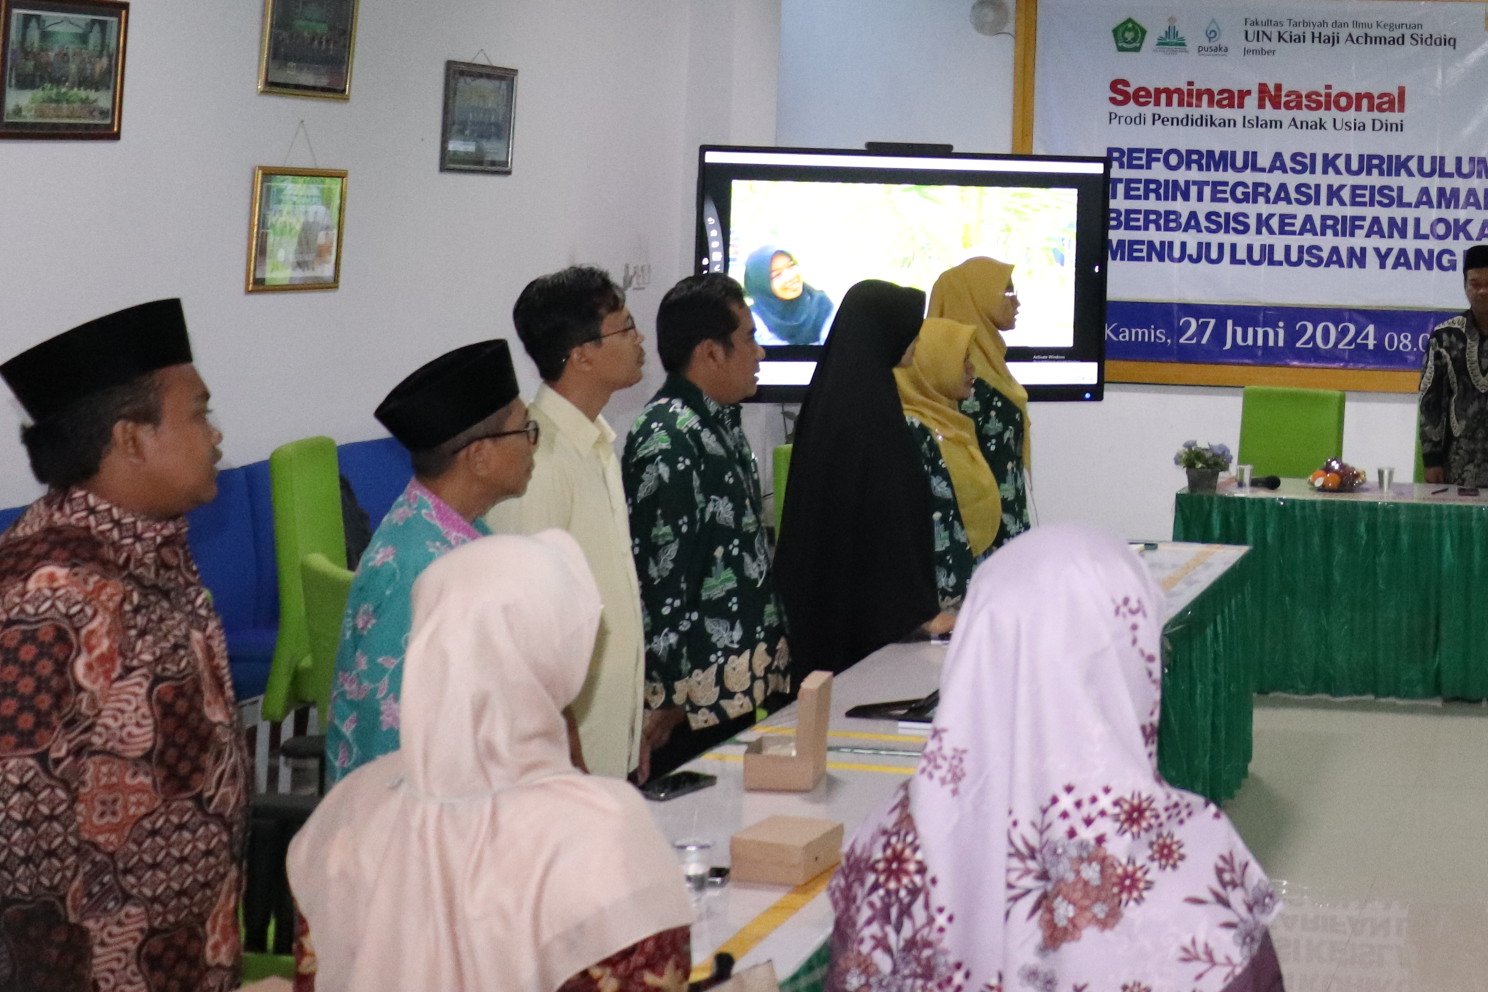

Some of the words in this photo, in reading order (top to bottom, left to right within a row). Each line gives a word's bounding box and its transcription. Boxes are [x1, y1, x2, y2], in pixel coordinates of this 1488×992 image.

[1244, 18, 1284, 28] Fakultas
[1287, 18, 1329, 30] Tarbiyah
[1331, 20, 1349, 29] dan
[1352, 20, 1373, 30] Ilmu
[1376, 20, 1423, 32] Keguruan
[1198, 44, 1228, 54] pusaka
[1243, 47, 1276, 57] Jember
[1244, 30, 1272, 43] UIN
[1277, 30, 1306, 44] Kiai
[1311, 32, 1340, 47] Haji
[1344, 32, 1405, 46] Achmad
[1410, 33, 1457, 50] Siddiq
[1108, 78, 1252, 109] Seminar
[1258, 82, 1406, 113] Nasional
[1108, 112, 1146, 126] Prodi
[1152, 113, 1236, 128] Pendidikan
[1242, 115, 1283, 130] Islam
[1288, 117, 1328, 131] Anak
[1333, 118, 1366, 132] Usia
[1372, 118, 1404, 132] Dini
[1106, 146, 1316, 174] REFORMULASI
[1109, 178, 1321, 206] TERINTEGRASI
[1108, 208, 1250, 235] BERBASIS
[1256, 212, 1408, 240] KEARIFAN
[1107, 239, 1224, 266] MENUJU
[1230, 242, 1366, 269] LULUSAN
[1373, 246, 1457, 272] YANG
[1104, 322, 1172, 346] Kamis,
[1178, 316, 1216, 345] 27
[1222, 319, 1285, 351] Juni
[1296, 321, 1378, 350] 2024
